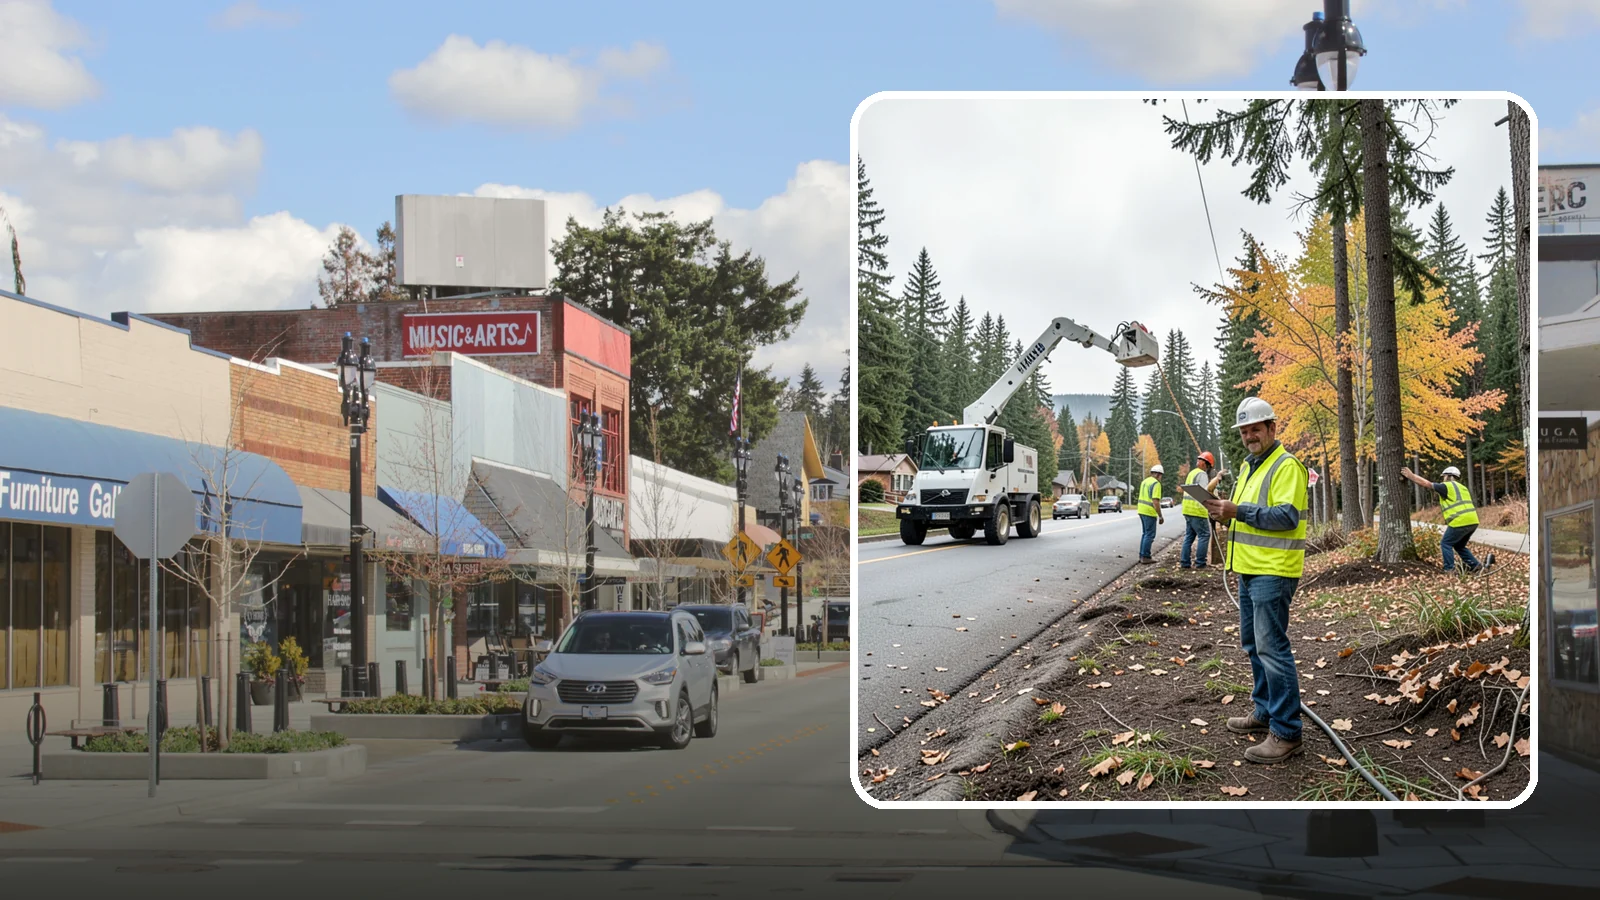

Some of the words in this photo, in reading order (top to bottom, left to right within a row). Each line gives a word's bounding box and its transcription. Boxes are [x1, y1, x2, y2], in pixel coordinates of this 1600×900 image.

[1540, 428, 1577, 436] UGA
[0, 471, 79, 515] Furniture
[89, 482, 122, 519] Gal
[453, 563, 479, 575] SUSHI
